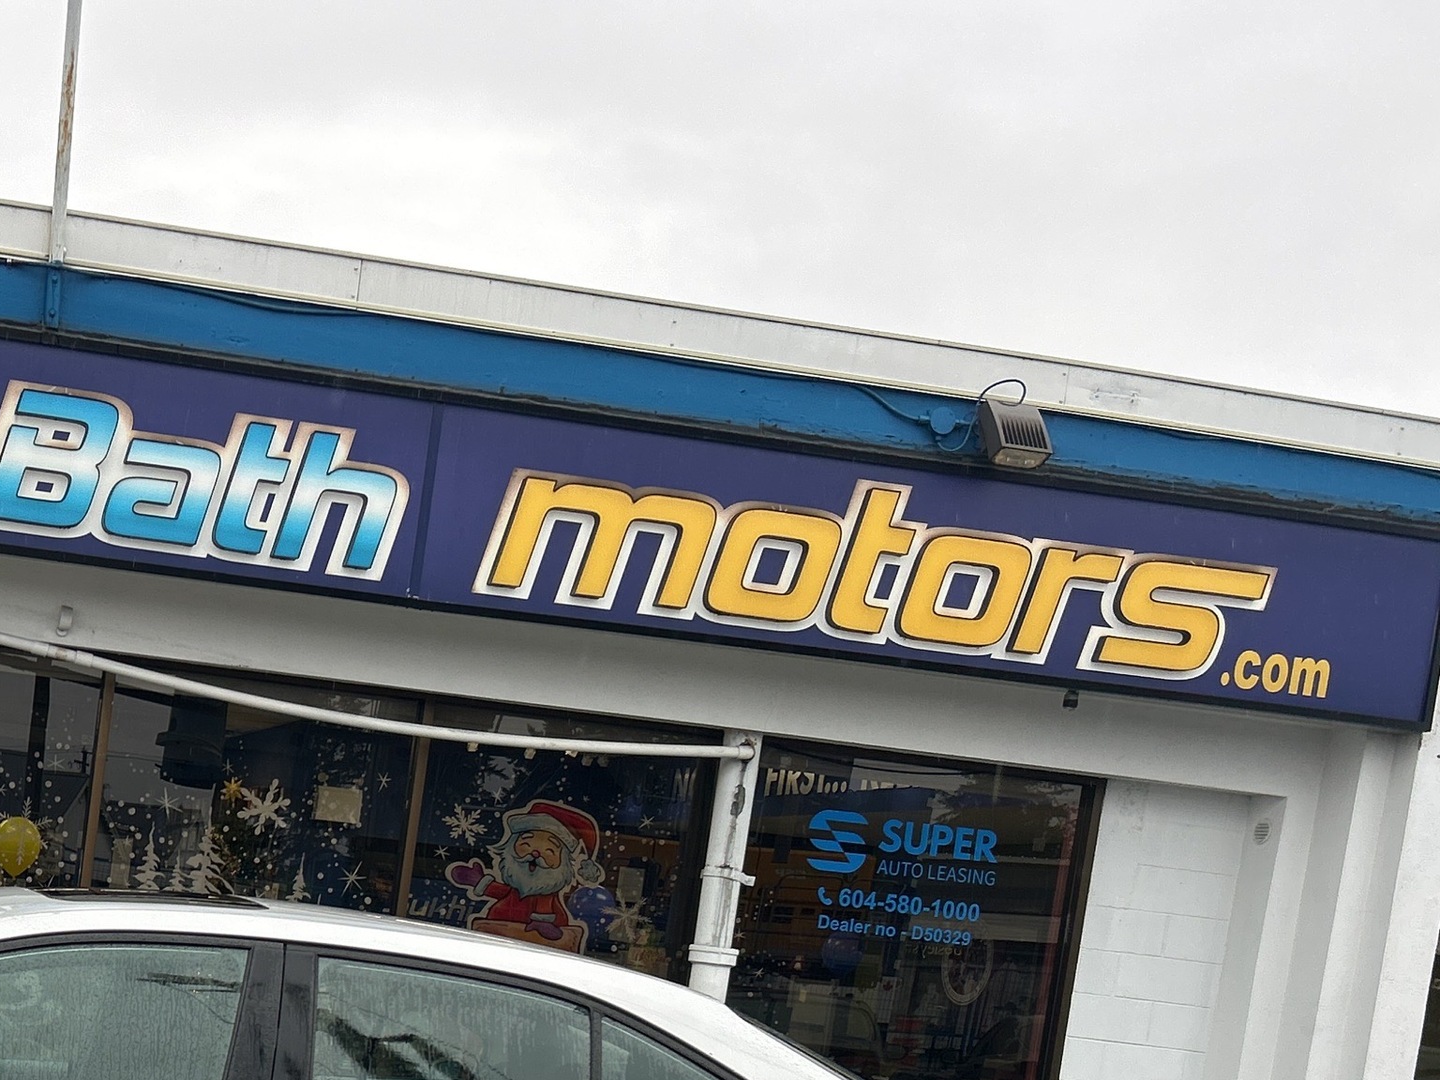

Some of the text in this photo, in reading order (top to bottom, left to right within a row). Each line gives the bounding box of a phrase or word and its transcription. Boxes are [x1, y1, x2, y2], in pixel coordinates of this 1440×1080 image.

[878, 818, 999, 864] SUPER
[876, 859, 997, 888] AUTO LEASING
[838, 888, 981, 923] 604-580-1000
[817, 914, 871, 937] Dealer
[876, 923, 897, 938] no
[911, 925, 972, 947] D50329
